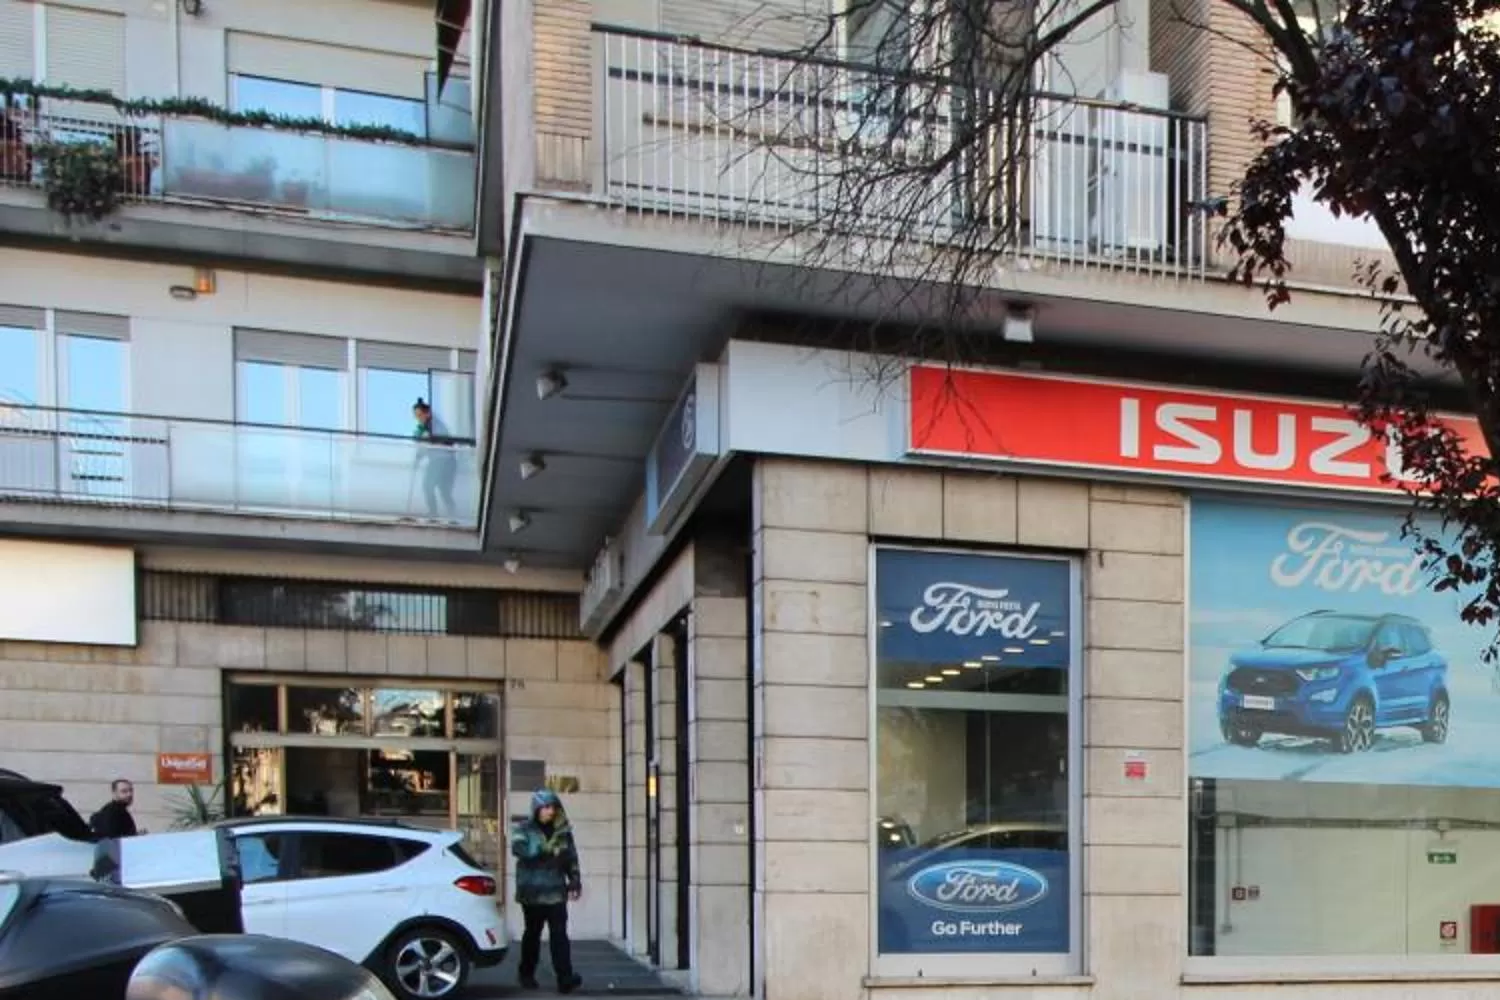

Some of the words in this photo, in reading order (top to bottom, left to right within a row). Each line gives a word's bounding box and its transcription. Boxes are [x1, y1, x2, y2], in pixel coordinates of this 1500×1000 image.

[1271, 522, 1426, 595] Ford
[910, 582, 1041, 638] Ford
[936, 867, 1019, 902] Ford
[931, 920, 957, 935] Go
[960, 920, 1023, 936] Further
